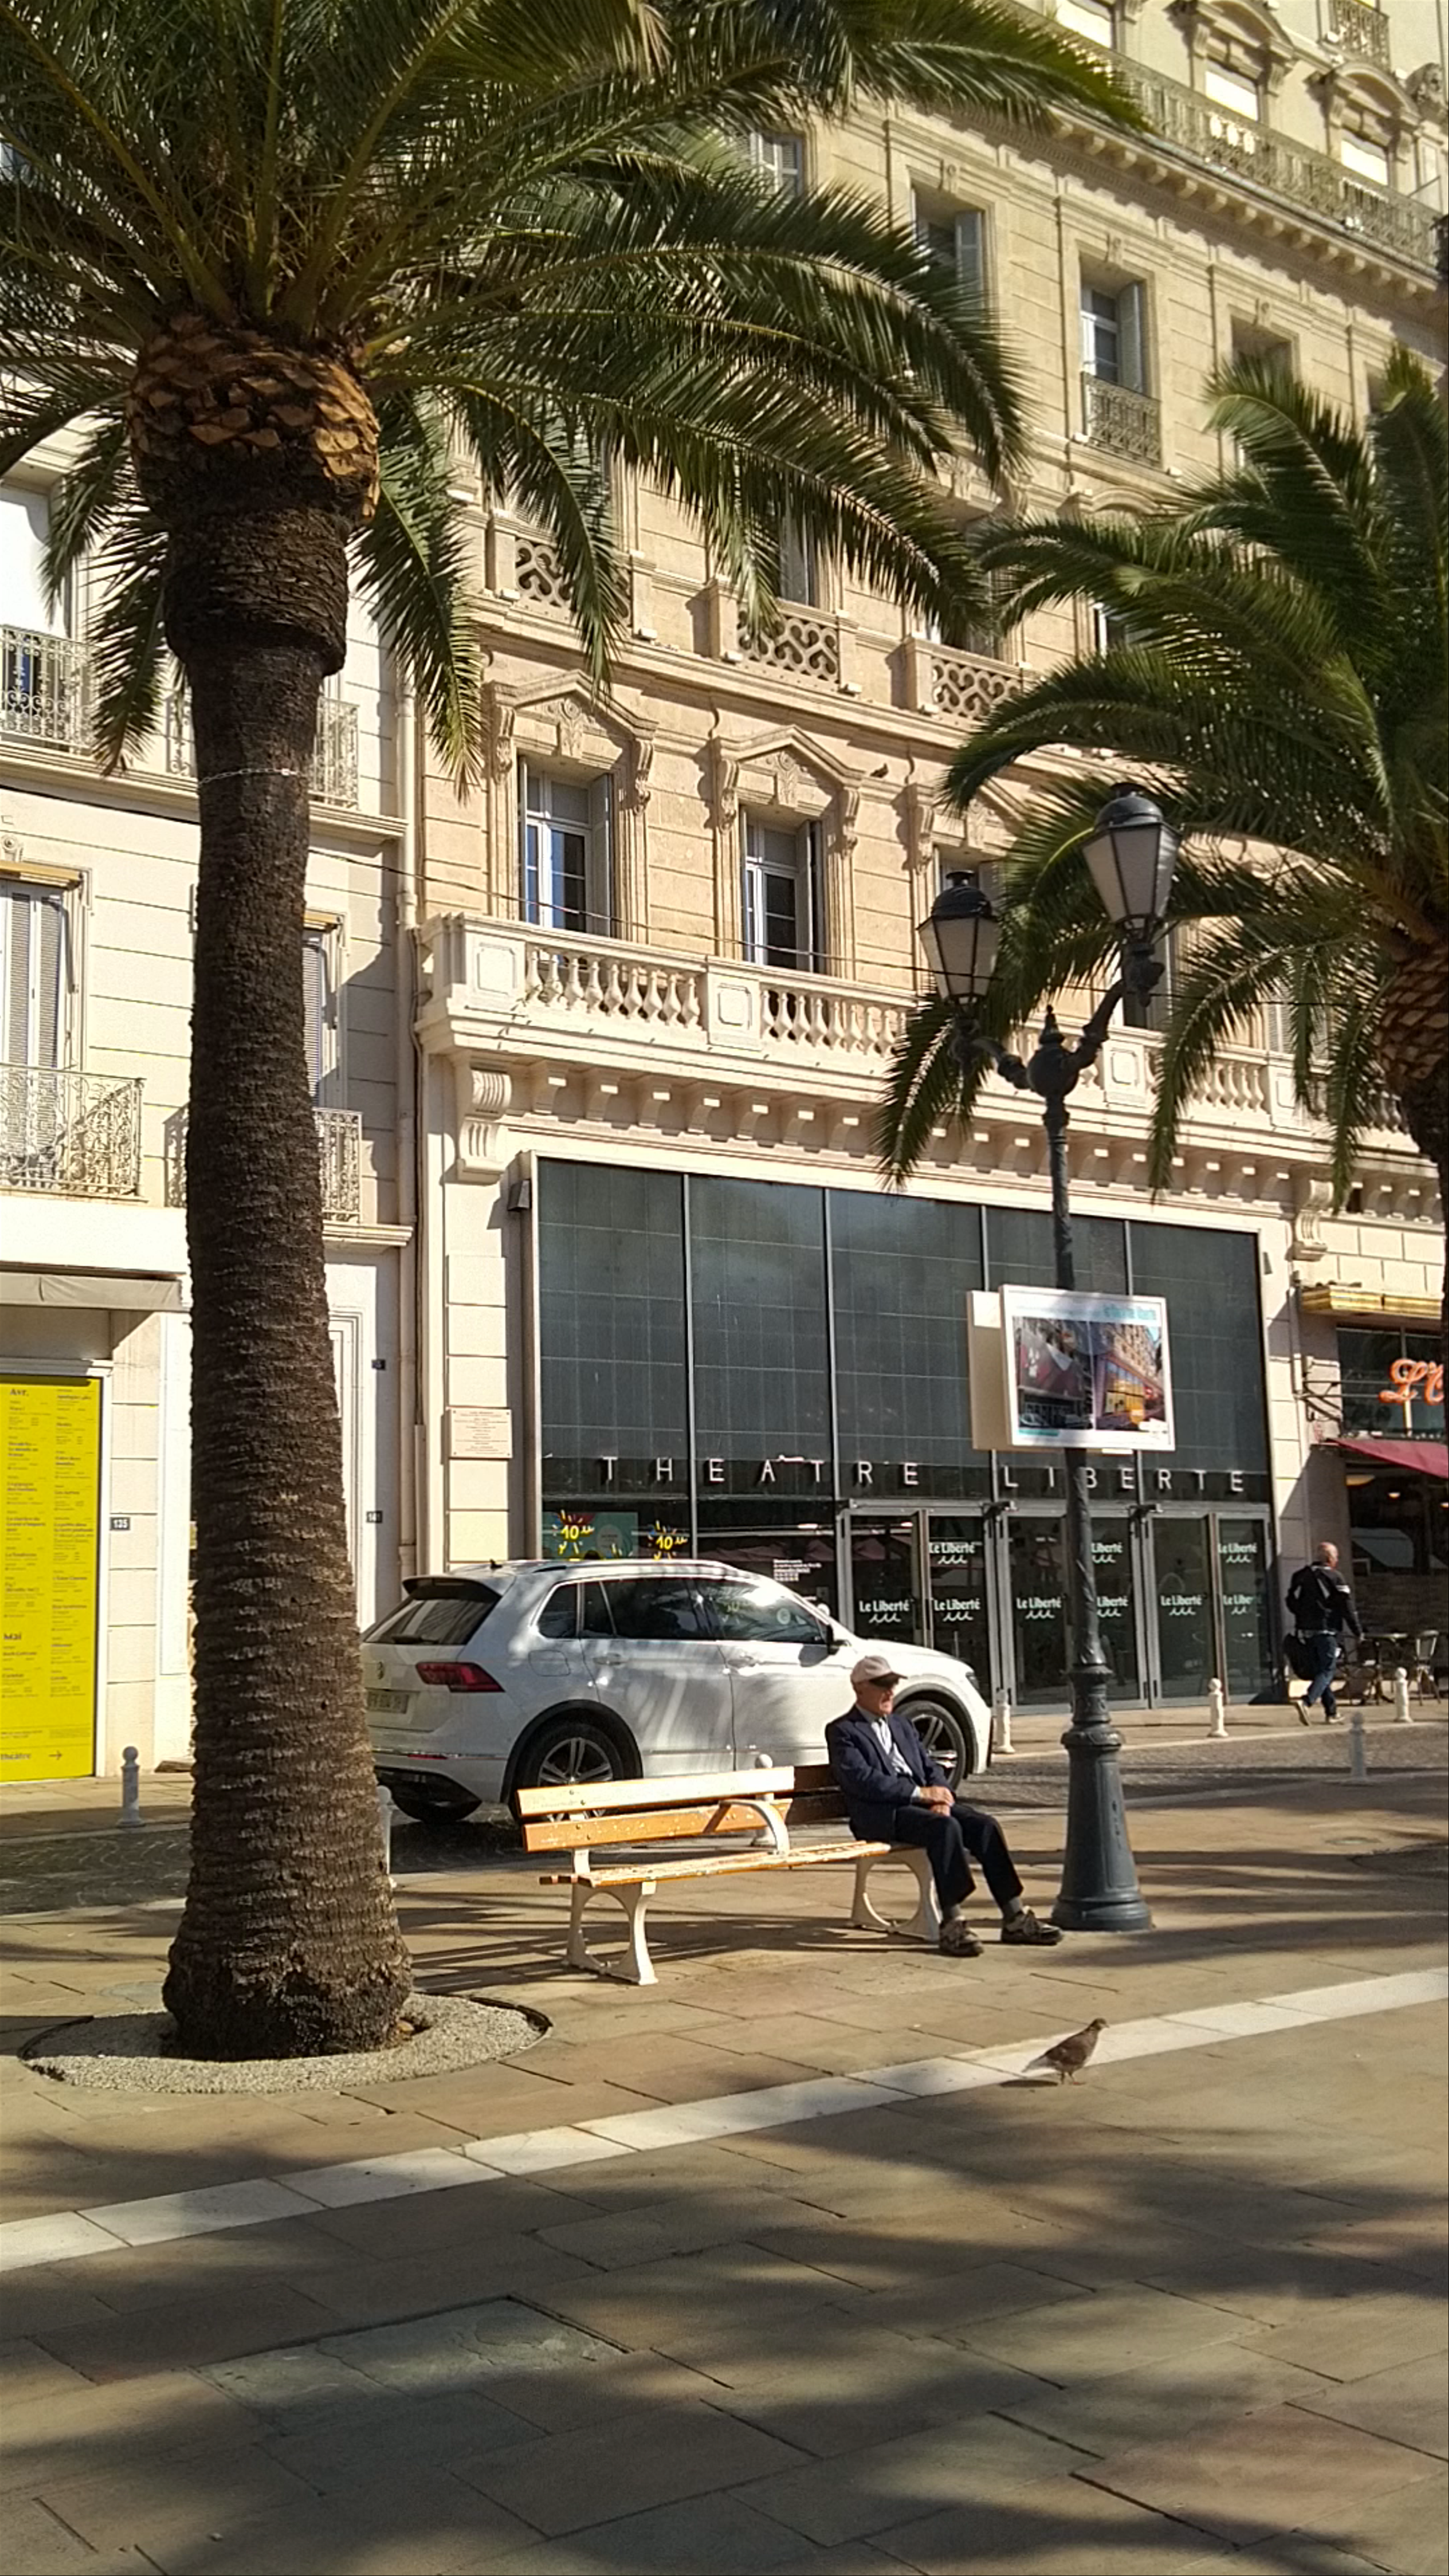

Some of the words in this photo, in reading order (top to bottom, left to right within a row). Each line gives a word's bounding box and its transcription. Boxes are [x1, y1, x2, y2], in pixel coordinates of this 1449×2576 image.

[603, 1456, 918, 1485] THEATRE
[1004, 1466, 1243, 1492] LIBERTE
[930, 1543, 939, 1553] Le
[941, 1543, 975, 1553] Liberté
[1218, 1543, 1227, 1553] Le
[1228, 1543, 1257, 1553] Liberté
[859, 1601, 871, 1612] Le
[873, 1599, 910, 1612] Liberté
[934, 1599, 944, 1611] Le
[946, 1598, 981, 1610] Liberté
[1017, 1597, 1028, 1609] Le
[1029, 1596, 1061, 1609] Liberté
[1097, 1596, 1128, 1607] Liberté
[1161, 1596, 1171, 1606] Le
[1172, 1595, 1202, 1606] Liberté
[1223, 1595, 1232, 1605] Le
